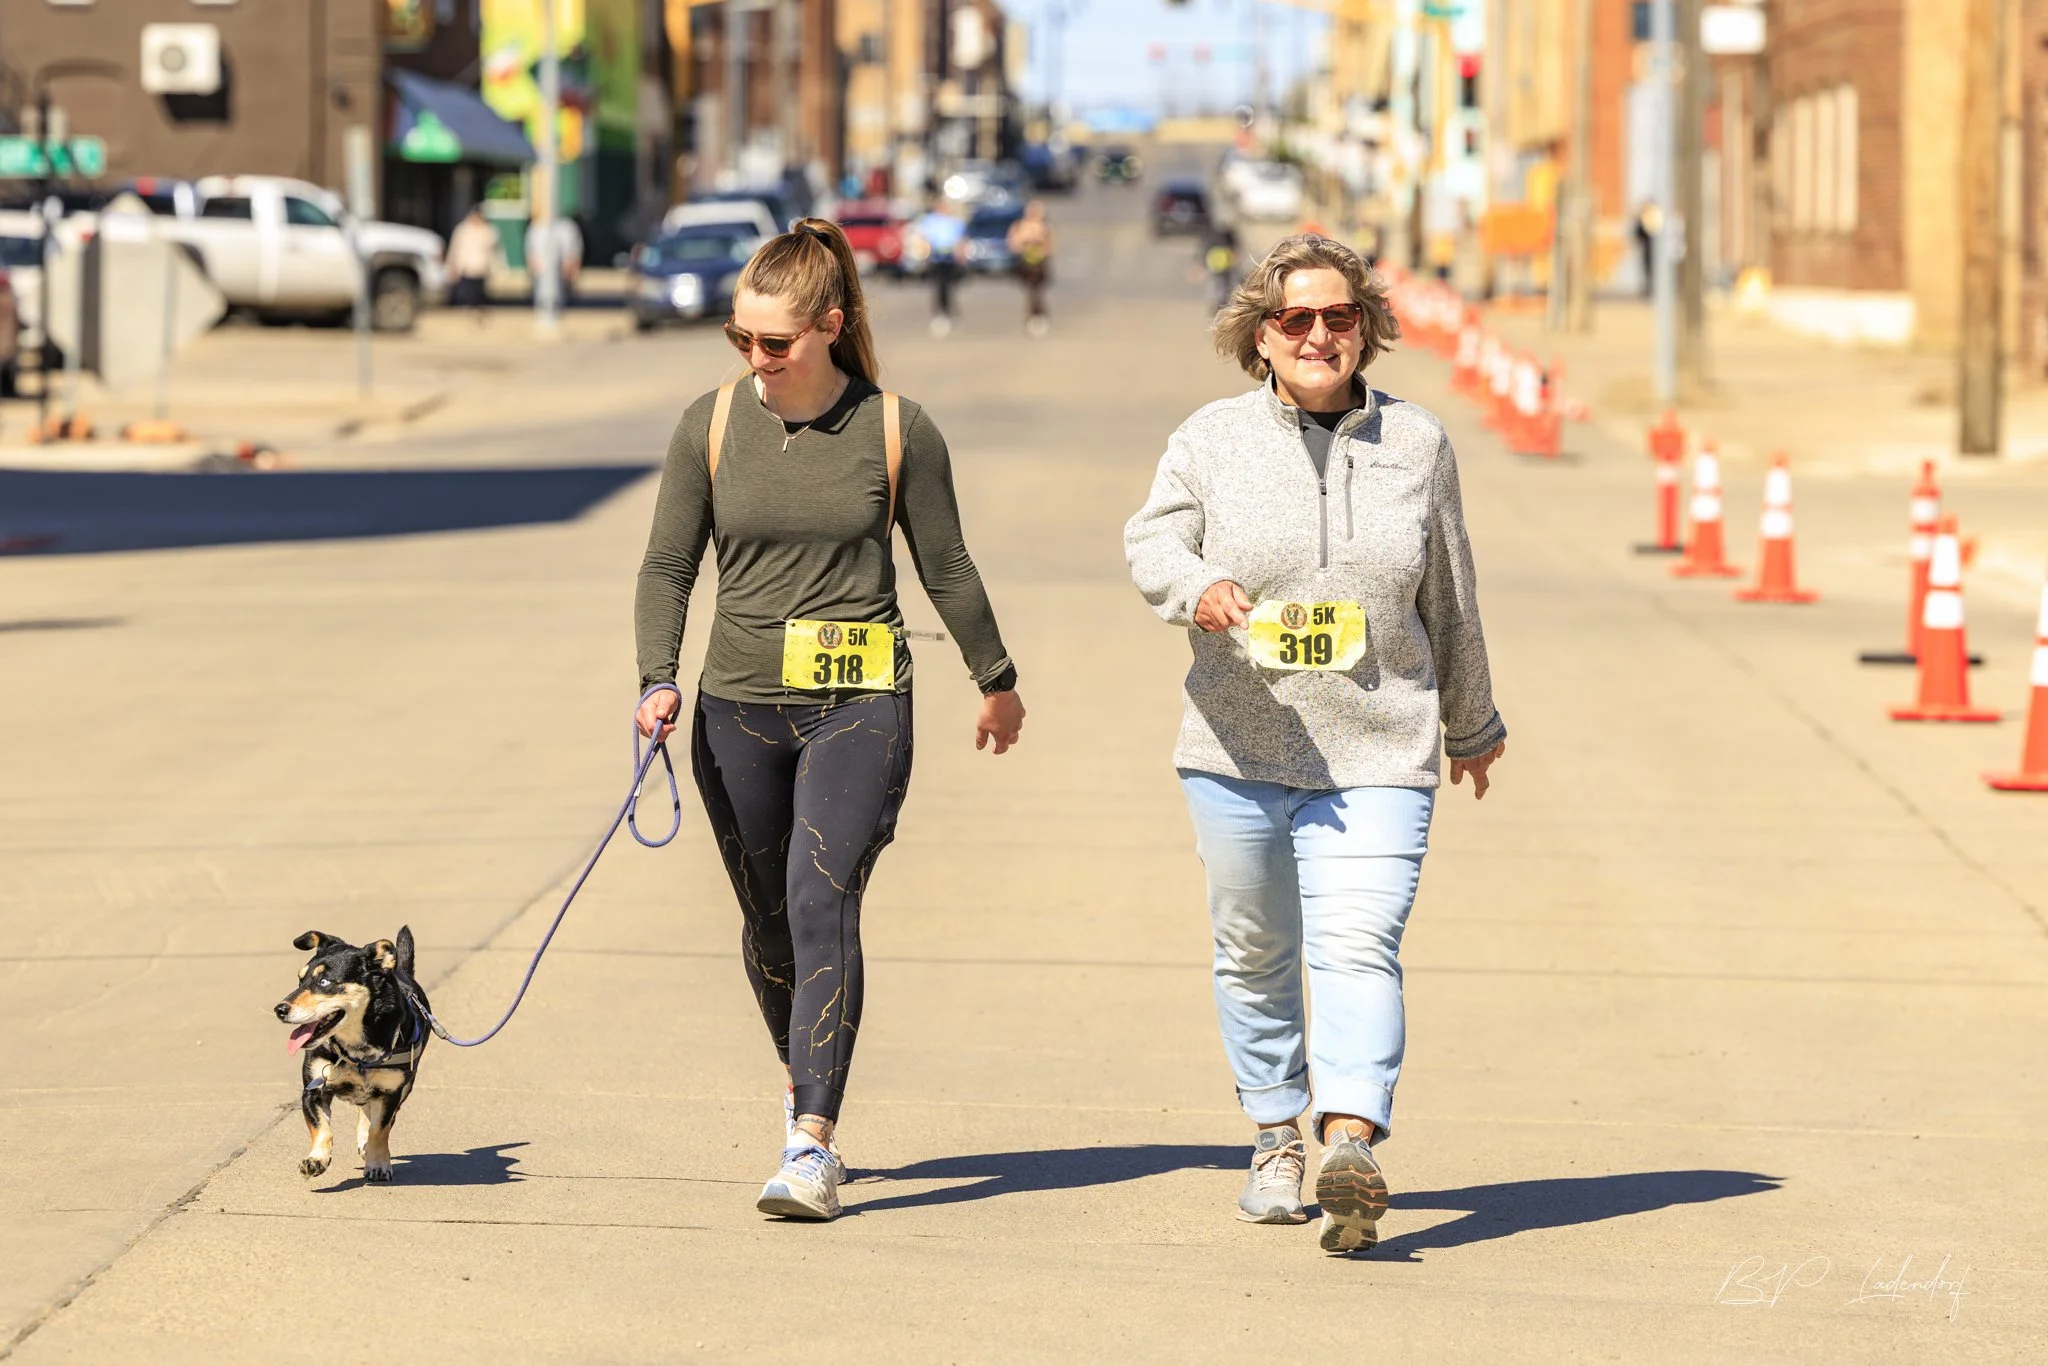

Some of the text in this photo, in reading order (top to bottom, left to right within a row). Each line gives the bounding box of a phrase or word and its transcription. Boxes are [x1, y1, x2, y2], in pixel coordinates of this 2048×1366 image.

[1313, 606, 1335, 625] 5K
[848, 628, 868, 646] 5K
[1279, 633, 1332, 665] 319
[813, 652, 863, 684] 318
